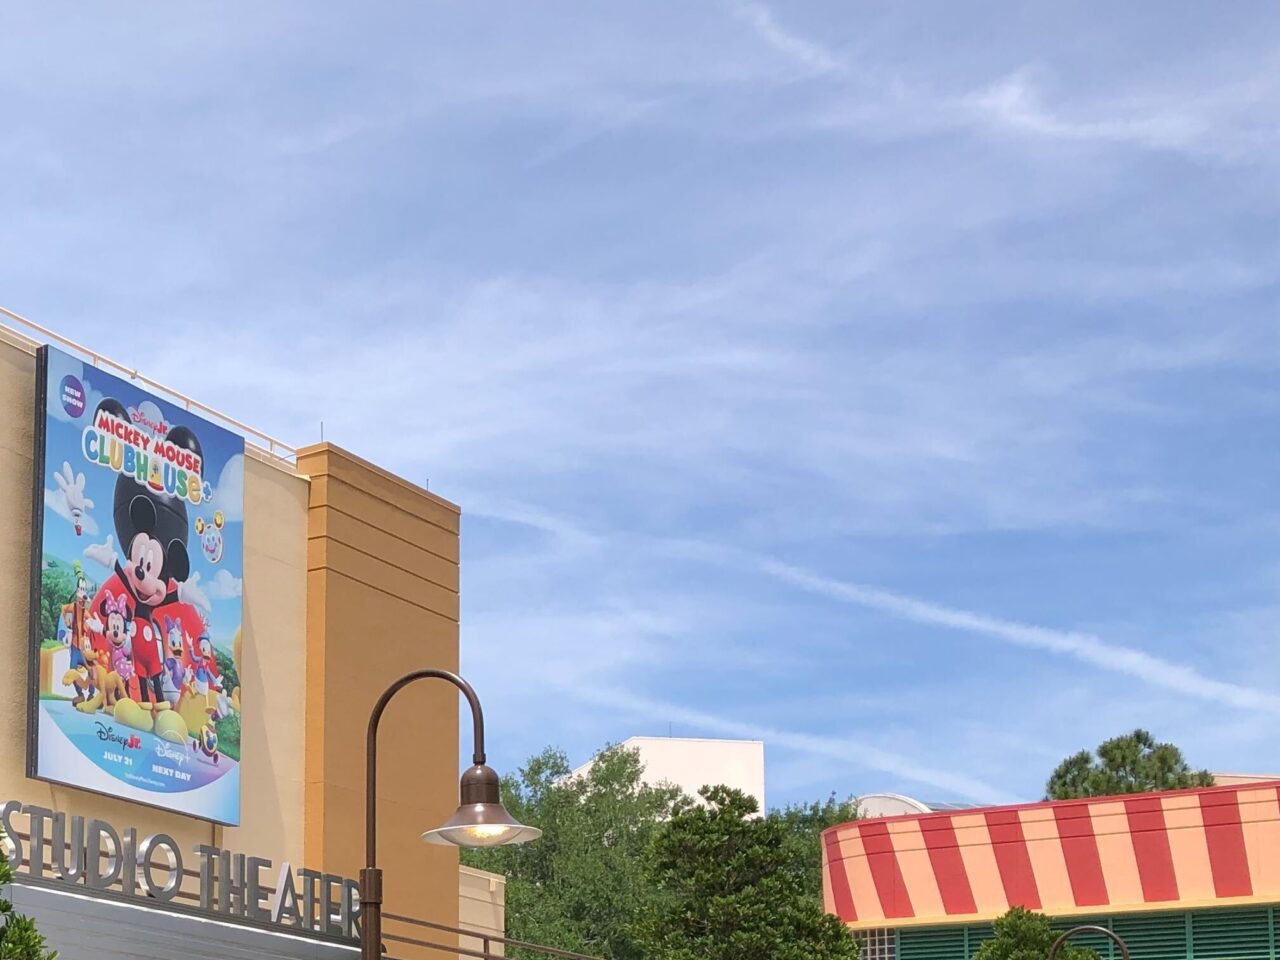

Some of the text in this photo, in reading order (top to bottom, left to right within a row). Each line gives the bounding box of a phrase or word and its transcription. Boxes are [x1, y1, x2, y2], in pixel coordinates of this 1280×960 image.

[64, 385, 81, 398] NEW
[62, 394, 83, 409] SHOW
[98, 416, 200, 474] MICKEY MOUSE
[95, 721, 128, 750] Disney
[103, 751, 133, 766] JULY 21
[152, 764, 173, 777] NEXT
[175, 770, 191, 781] DAY
[194, 844, 362, 940] THEATER
